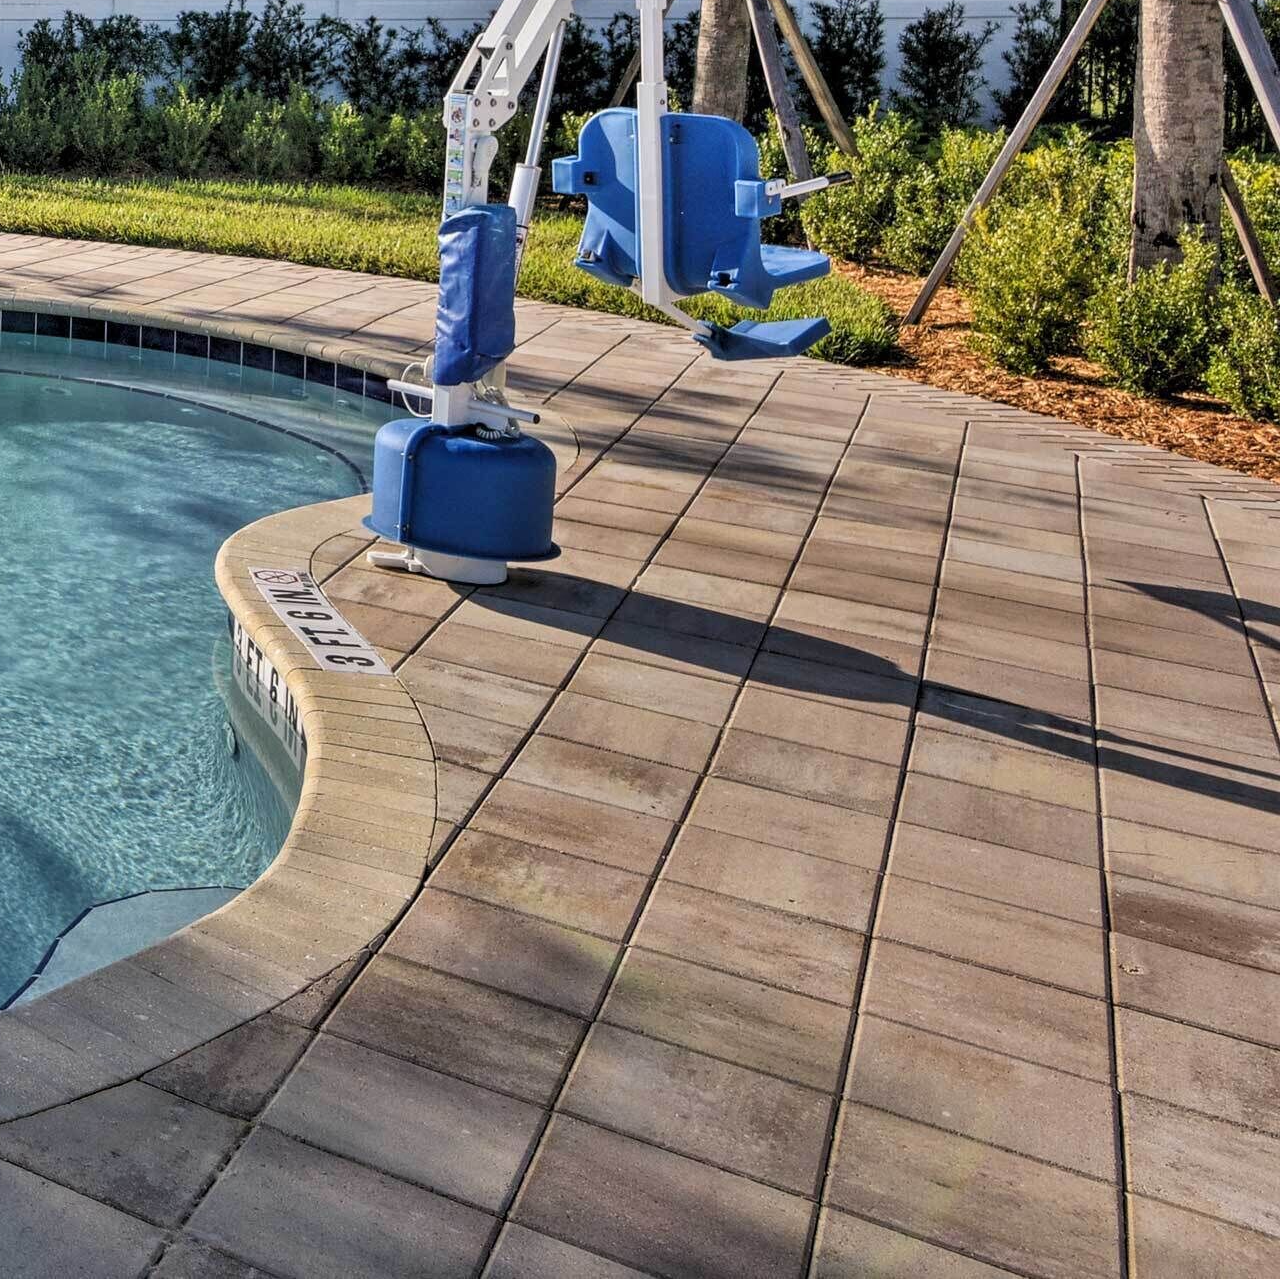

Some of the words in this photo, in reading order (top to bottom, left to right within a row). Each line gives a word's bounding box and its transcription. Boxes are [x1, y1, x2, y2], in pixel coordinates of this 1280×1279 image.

[286, 609, 334, 621] 6
[325, 653, 376, 667] 3
[246, 637, 263, 683] FT
[269, 666, 279, 703] 6
[285, 685, 299, 732] IN
